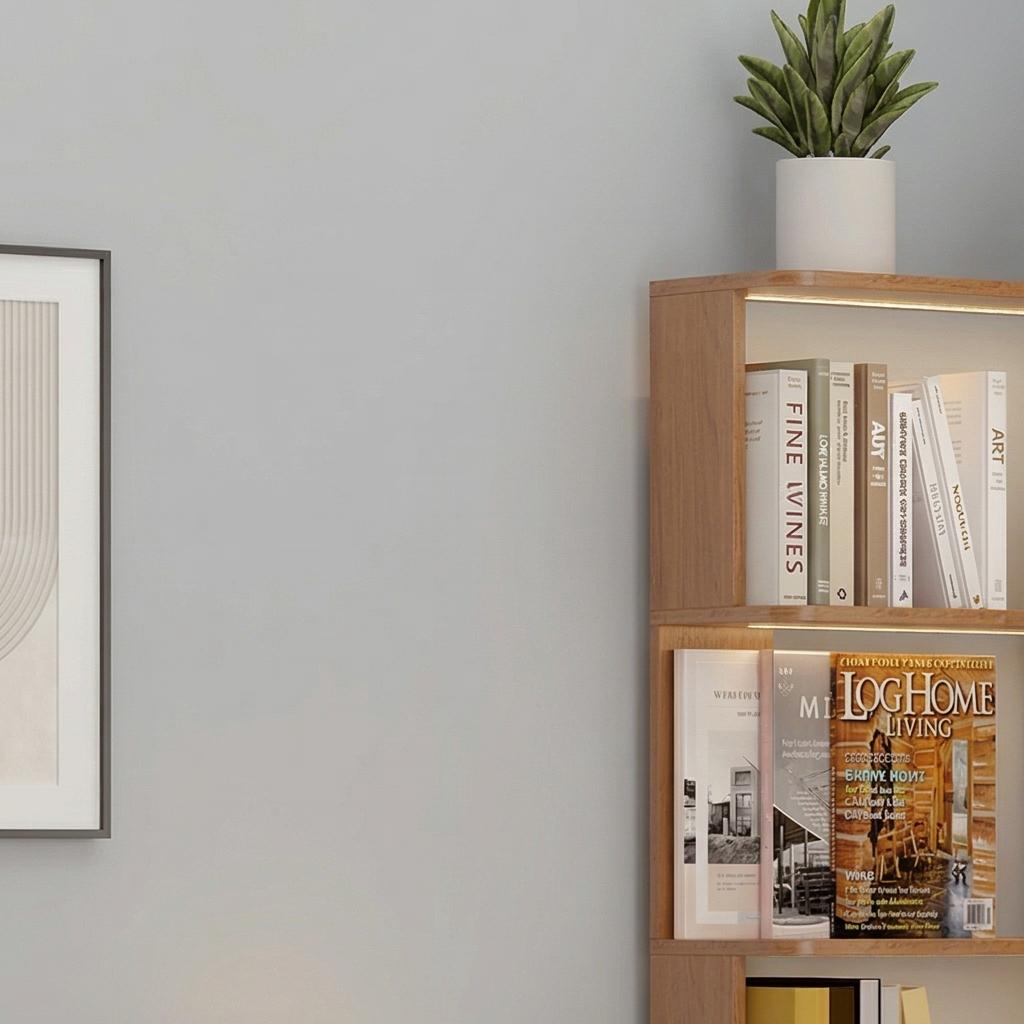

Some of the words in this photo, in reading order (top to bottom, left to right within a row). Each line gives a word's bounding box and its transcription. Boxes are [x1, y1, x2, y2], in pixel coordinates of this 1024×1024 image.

[785, 402, 803, 465] FINE
[991, 428, 1005, 464] ART
[887, 714, 952, 738] LIVING
